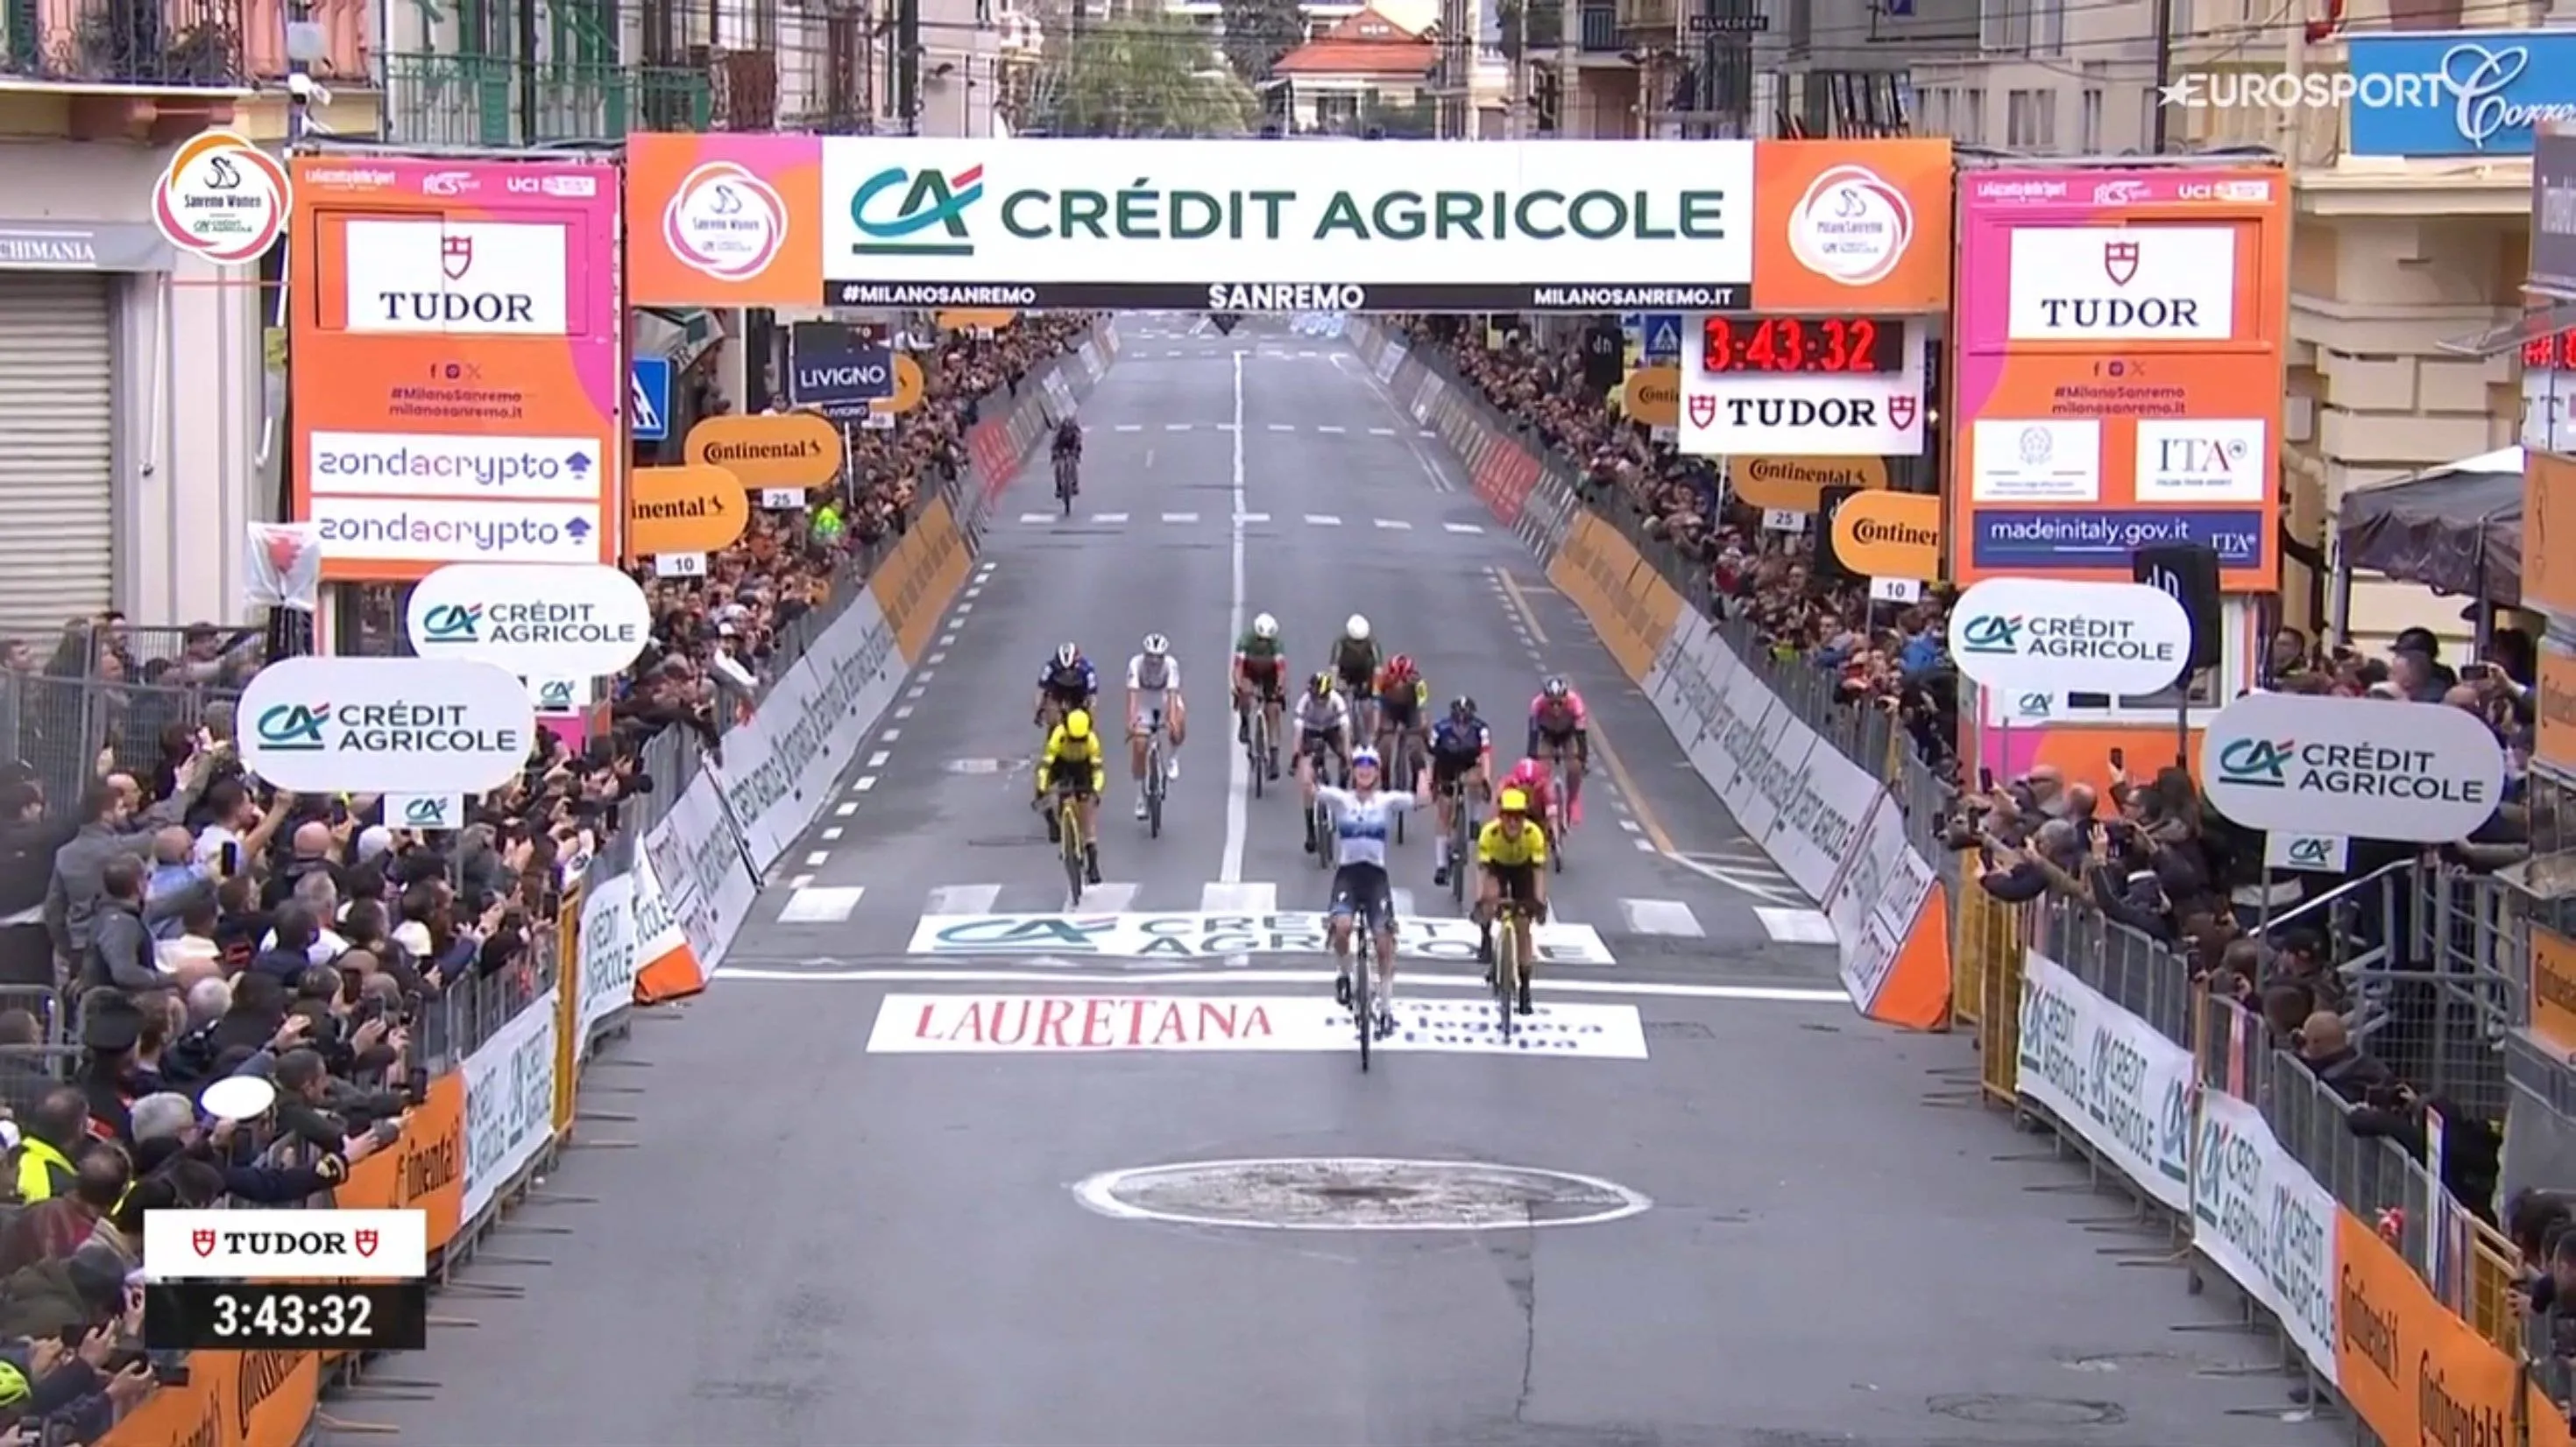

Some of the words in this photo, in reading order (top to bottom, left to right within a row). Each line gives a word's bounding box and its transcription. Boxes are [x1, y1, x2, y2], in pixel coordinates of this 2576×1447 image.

[507, 178, 539, 193] UCI
[2179, 184, 2211, 199] UCI
[184, 194, 224, 208] Sanremo
[227, 194, 261, 208] Women
[1001, 178, 1296, 240] CRÉDIT
[1313, 190, 1724, 240] AGRICOLE
[379, 292, 534, 323] TUDOR
[842, 285, 1037, 306] #MILANOSANREMO
[1208, 285, 1366, 309] SANREMO
[1533, 287, 1734, 307] MILANOSANREMO.IT
[2042, 299, 2199, 328] TUDOR
[1705, 320, 1877, 371] 3:43:32
[799, 366, 886, 387] LIVIGNO
[1727, 399, 1878, 427] TUDOR
[703, 441, 806, 465] Continental
[2158, 438, 2232, 473] ITA
[319, 447, 559, 487] zondacrypto
[1749, 459, 1851, 484] Continental
[773, 494, 790, 505] 25
[1775, 512, 1794, 524] 25
[319, 512, 559, 552] zondacrypto
[1991, 517, 2190, 544] madeinitaly.gov.it
[675, 557, 694, 571] 10
[1886, 582, 1905, 597] 10
[490, 600, 595, 625] CRÉDIT
[490, 624, 636, 643] AGRICOLE
[2028, 615, 2134, 639] CRÉDIT
[2028, 639, 2174, 661] AGRICOLE
[338, 700, 467, 727] CRÉDIT
[339, 731, 517, 752] AGRICOLE
[2302, 741, 2435, 773] CRÉDIT
[2299, 773, 2484, 804] AGRICOLE
[914, 999, 1272, 1047] LAURETANA
